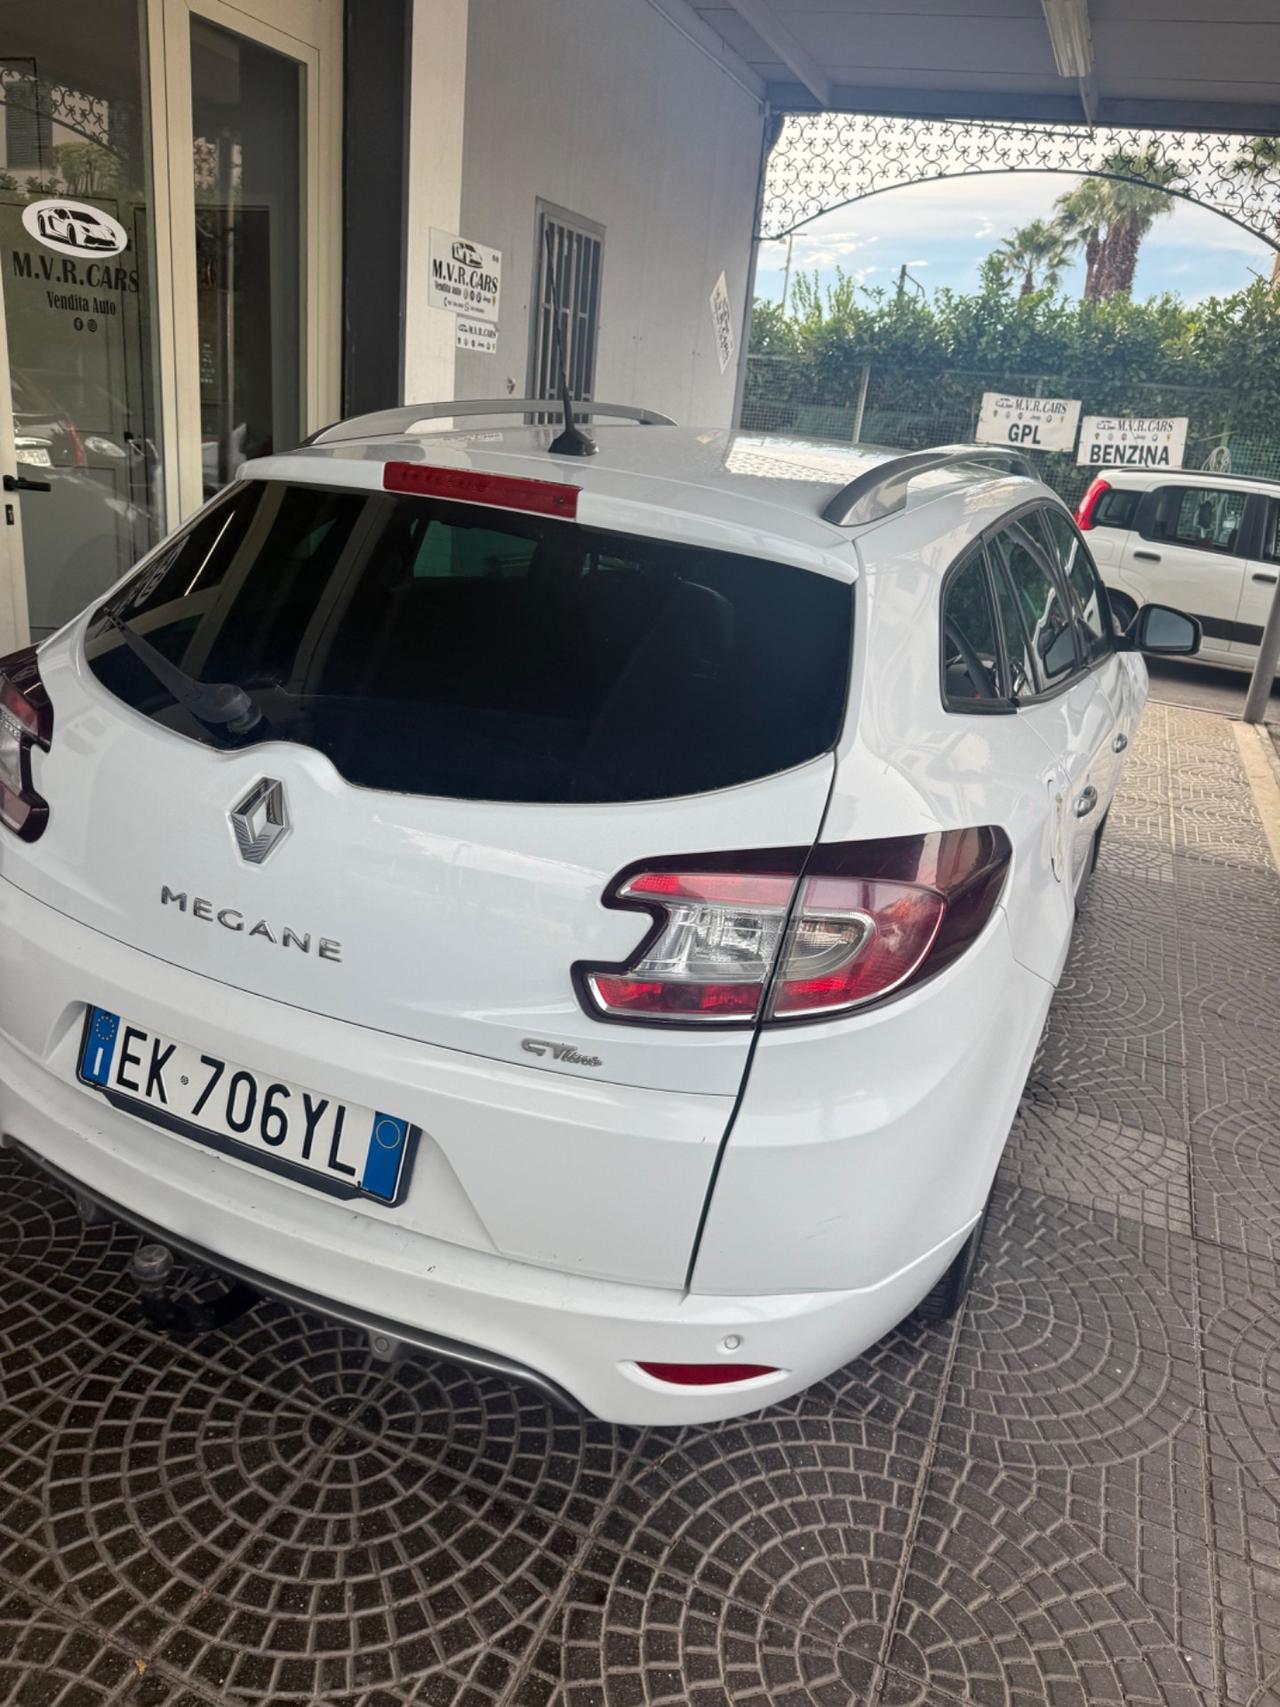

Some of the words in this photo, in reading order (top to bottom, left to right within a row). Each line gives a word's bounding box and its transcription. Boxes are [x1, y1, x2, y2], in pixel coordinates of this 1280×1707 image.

[46, 291, 89, 313] Vendita
[93, 297, 116, 316] Auto
[1008, 423, 1042, 445] GPL
[1089, 443, 1170, 467] BENZINA
[160, 885, 343, 963] MEGANE
[115, 1025, 177, 1106] EK
